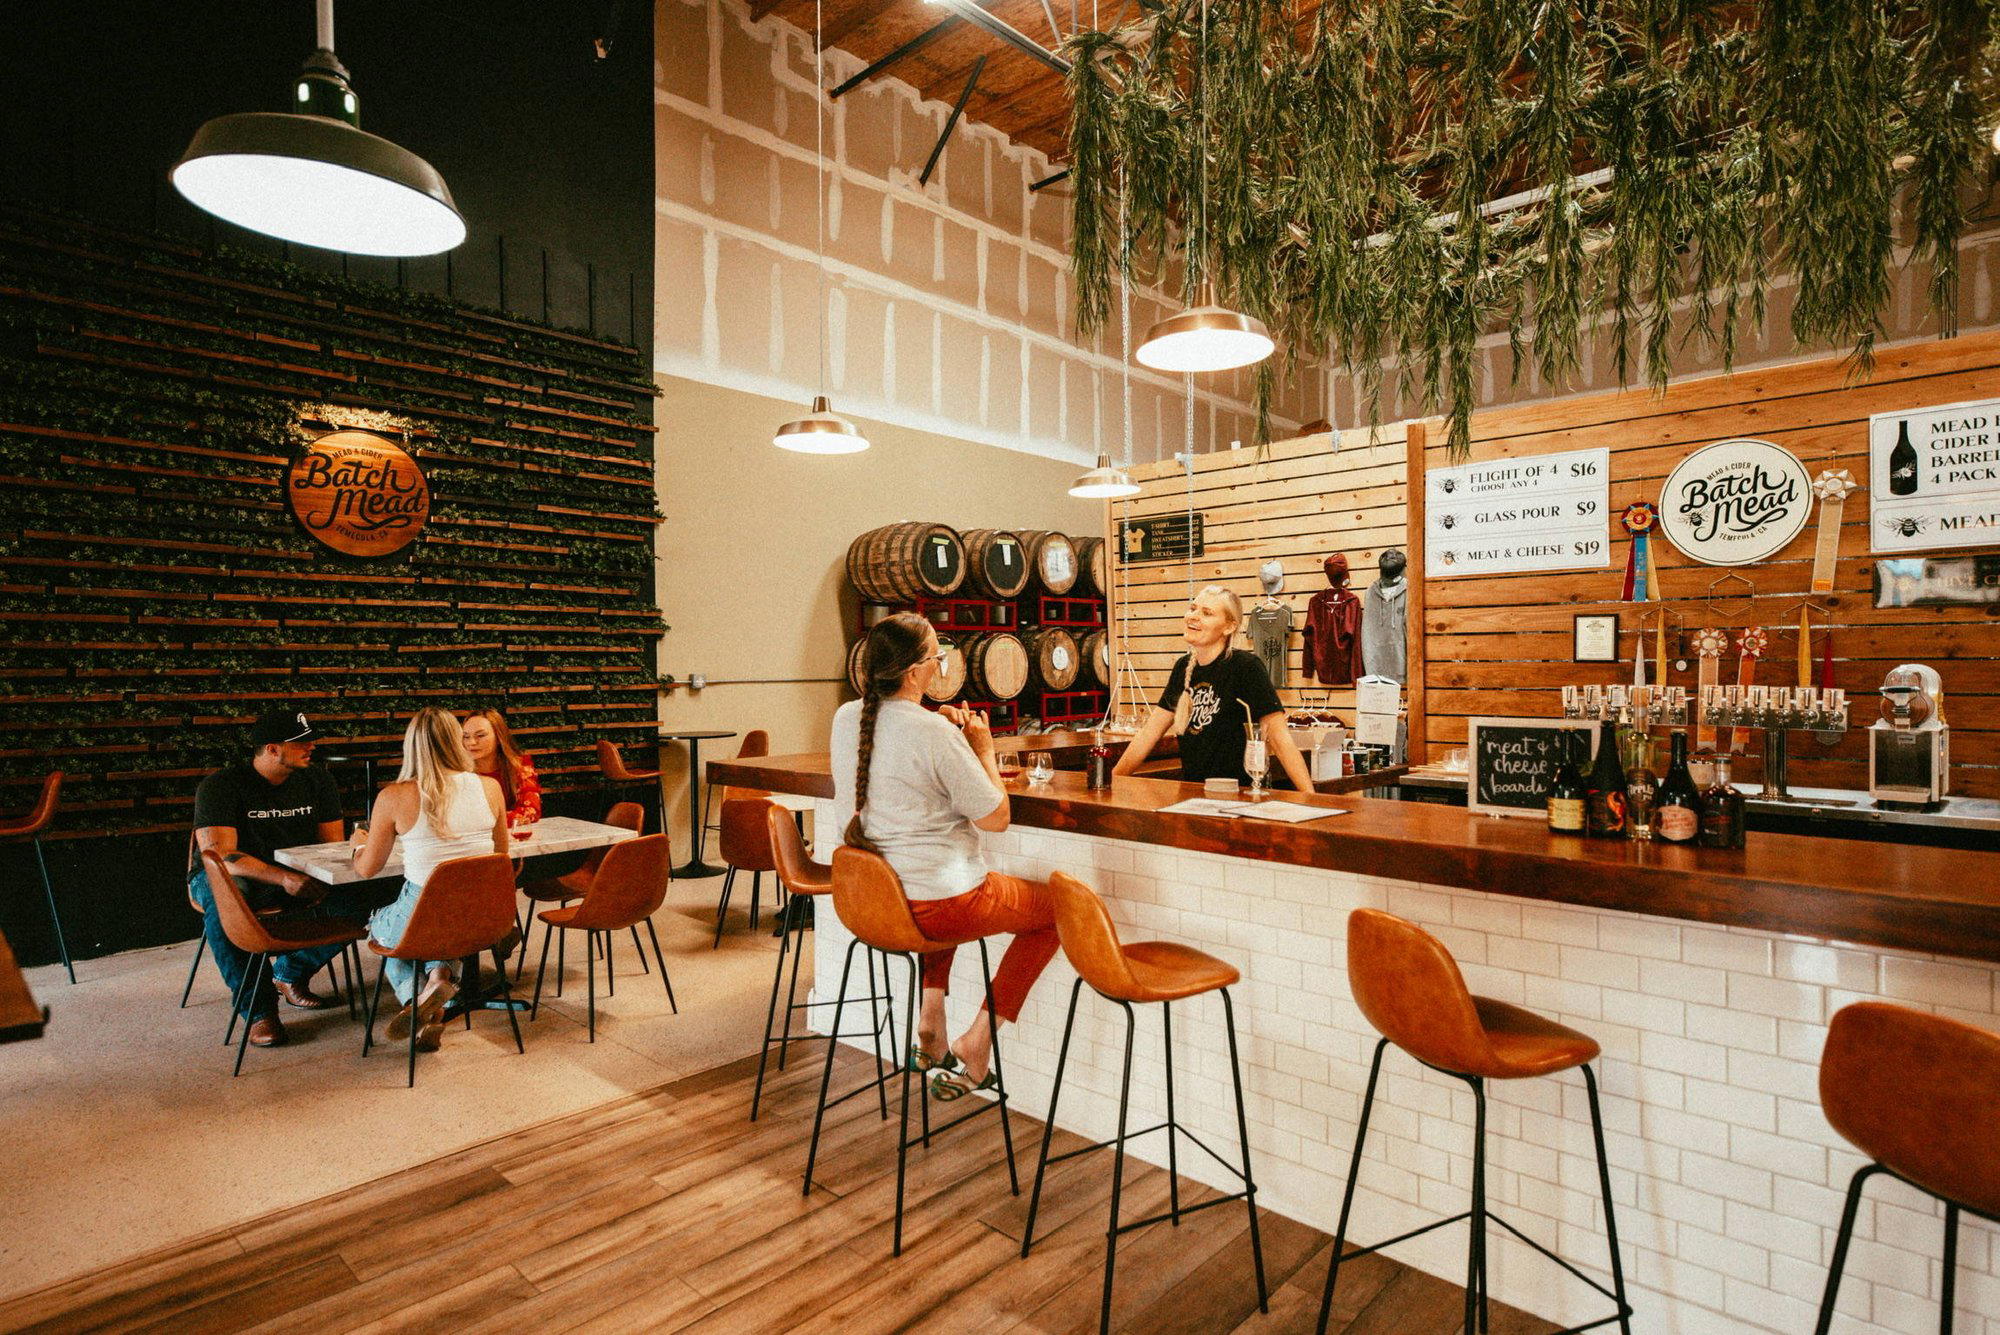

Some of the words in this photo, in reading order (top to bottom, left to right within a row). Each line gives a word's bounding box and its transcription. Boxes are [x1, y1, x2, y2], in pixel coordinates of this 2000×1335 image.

[1931, 417, 1987, 434] MEAD
[1930, 434, 1989, 450] CIDER
[331, 448, 353, 460] MEAD
[361, 448, 383, 460] CIDER
[294, 451, 417, 493] Batch
[1470, 468, 1520, 483] FLIGHT
[1525, 466, 1545, 477] OF
[1550, 463, 1559, 475] 4
[1571, 461, 1597, 478] $16
[1706, 469, 1724, 482] MEAD
[1731, 462, 1752, 470] CIDER
[1931, 473, 1941, 484] 4
[1949, 467, 1997, 483] PACK
[1471, 483, 1506, 493] CHOOSE
[1510, 480, 1528, 489] ANY
[1532, 479, 1538, 487] 4
[1680, 465, 1787, 513] Batch
[306, 487, 426, 531] Mead
[1474, 510, 1517, 524] GLASS
[1522, 505, 1560, 519] POUR
[1576, 500, 1597, 516] $9
[1693, 478, 1799, 542] Mead
[1467, 549, 1501, 561] MEAT
[1504, 548, 1513, 558] &
[1516, 544, 1565, 558] CHEESE
[1574, 540, 1600, 556] $19
[1486, 736, 1537, 756] meat
[1494, 755, 1548, 774] cheese
[1491, 773, 1547, 796] boards
[247, 805, 313, 819] carhartt
